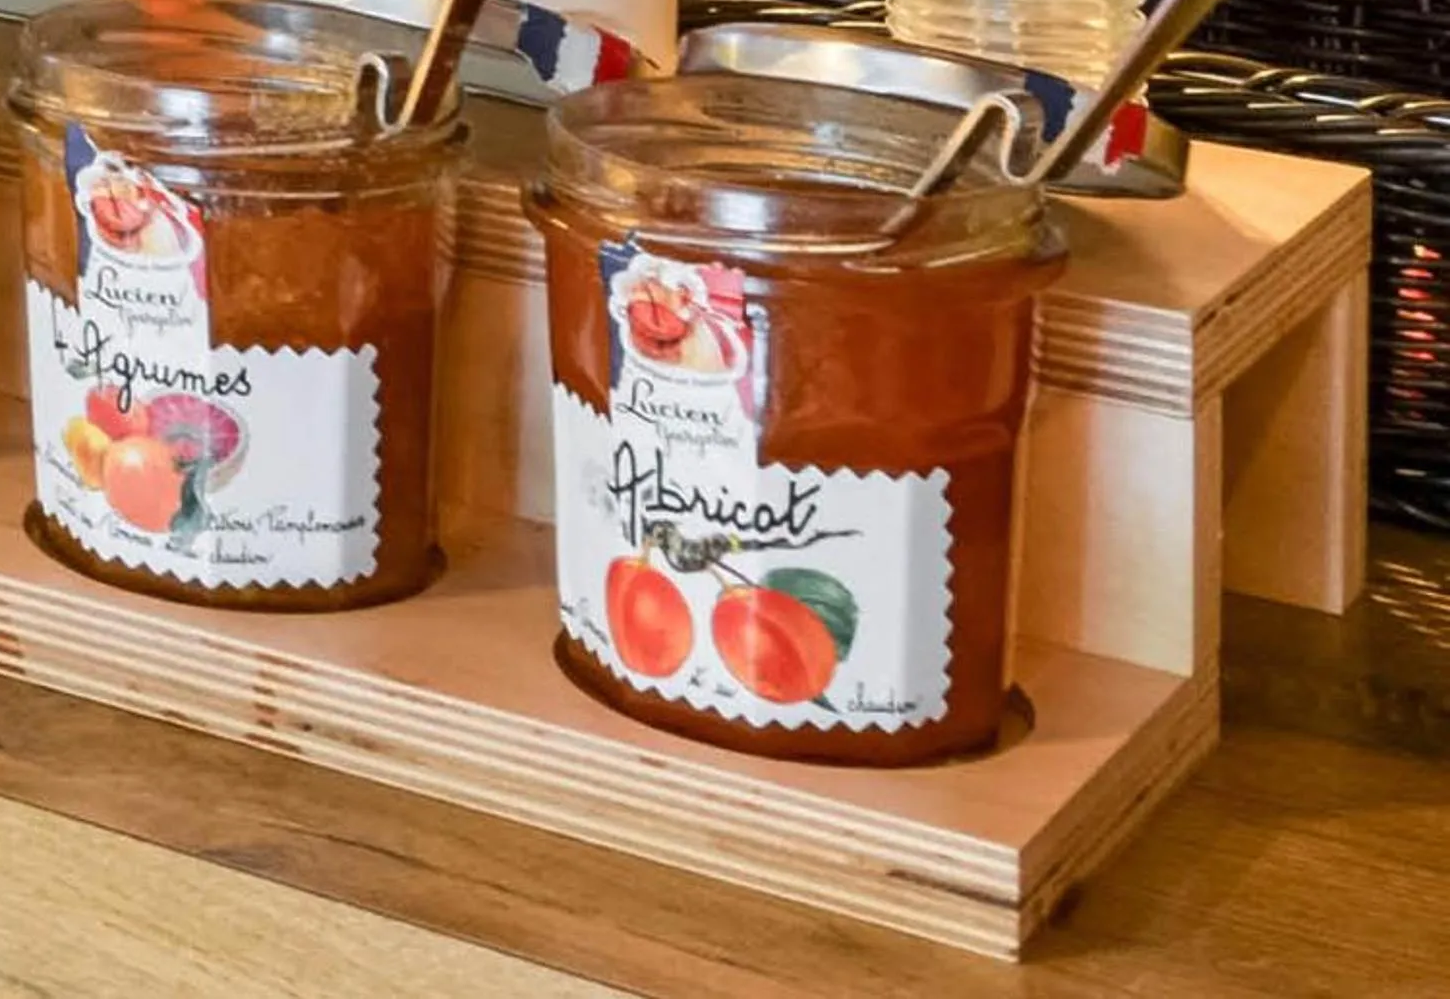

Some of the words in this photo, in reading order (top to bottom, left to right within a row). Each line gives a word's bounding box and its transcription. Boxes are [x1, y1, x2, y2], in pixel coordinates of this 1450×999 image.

[85, 265, 184, 309] Lucien
[73, 319, 252, 413] Agrumes
[615, 378, 724, 426] Lucien
[607, 440, 821, 547] Abricot
